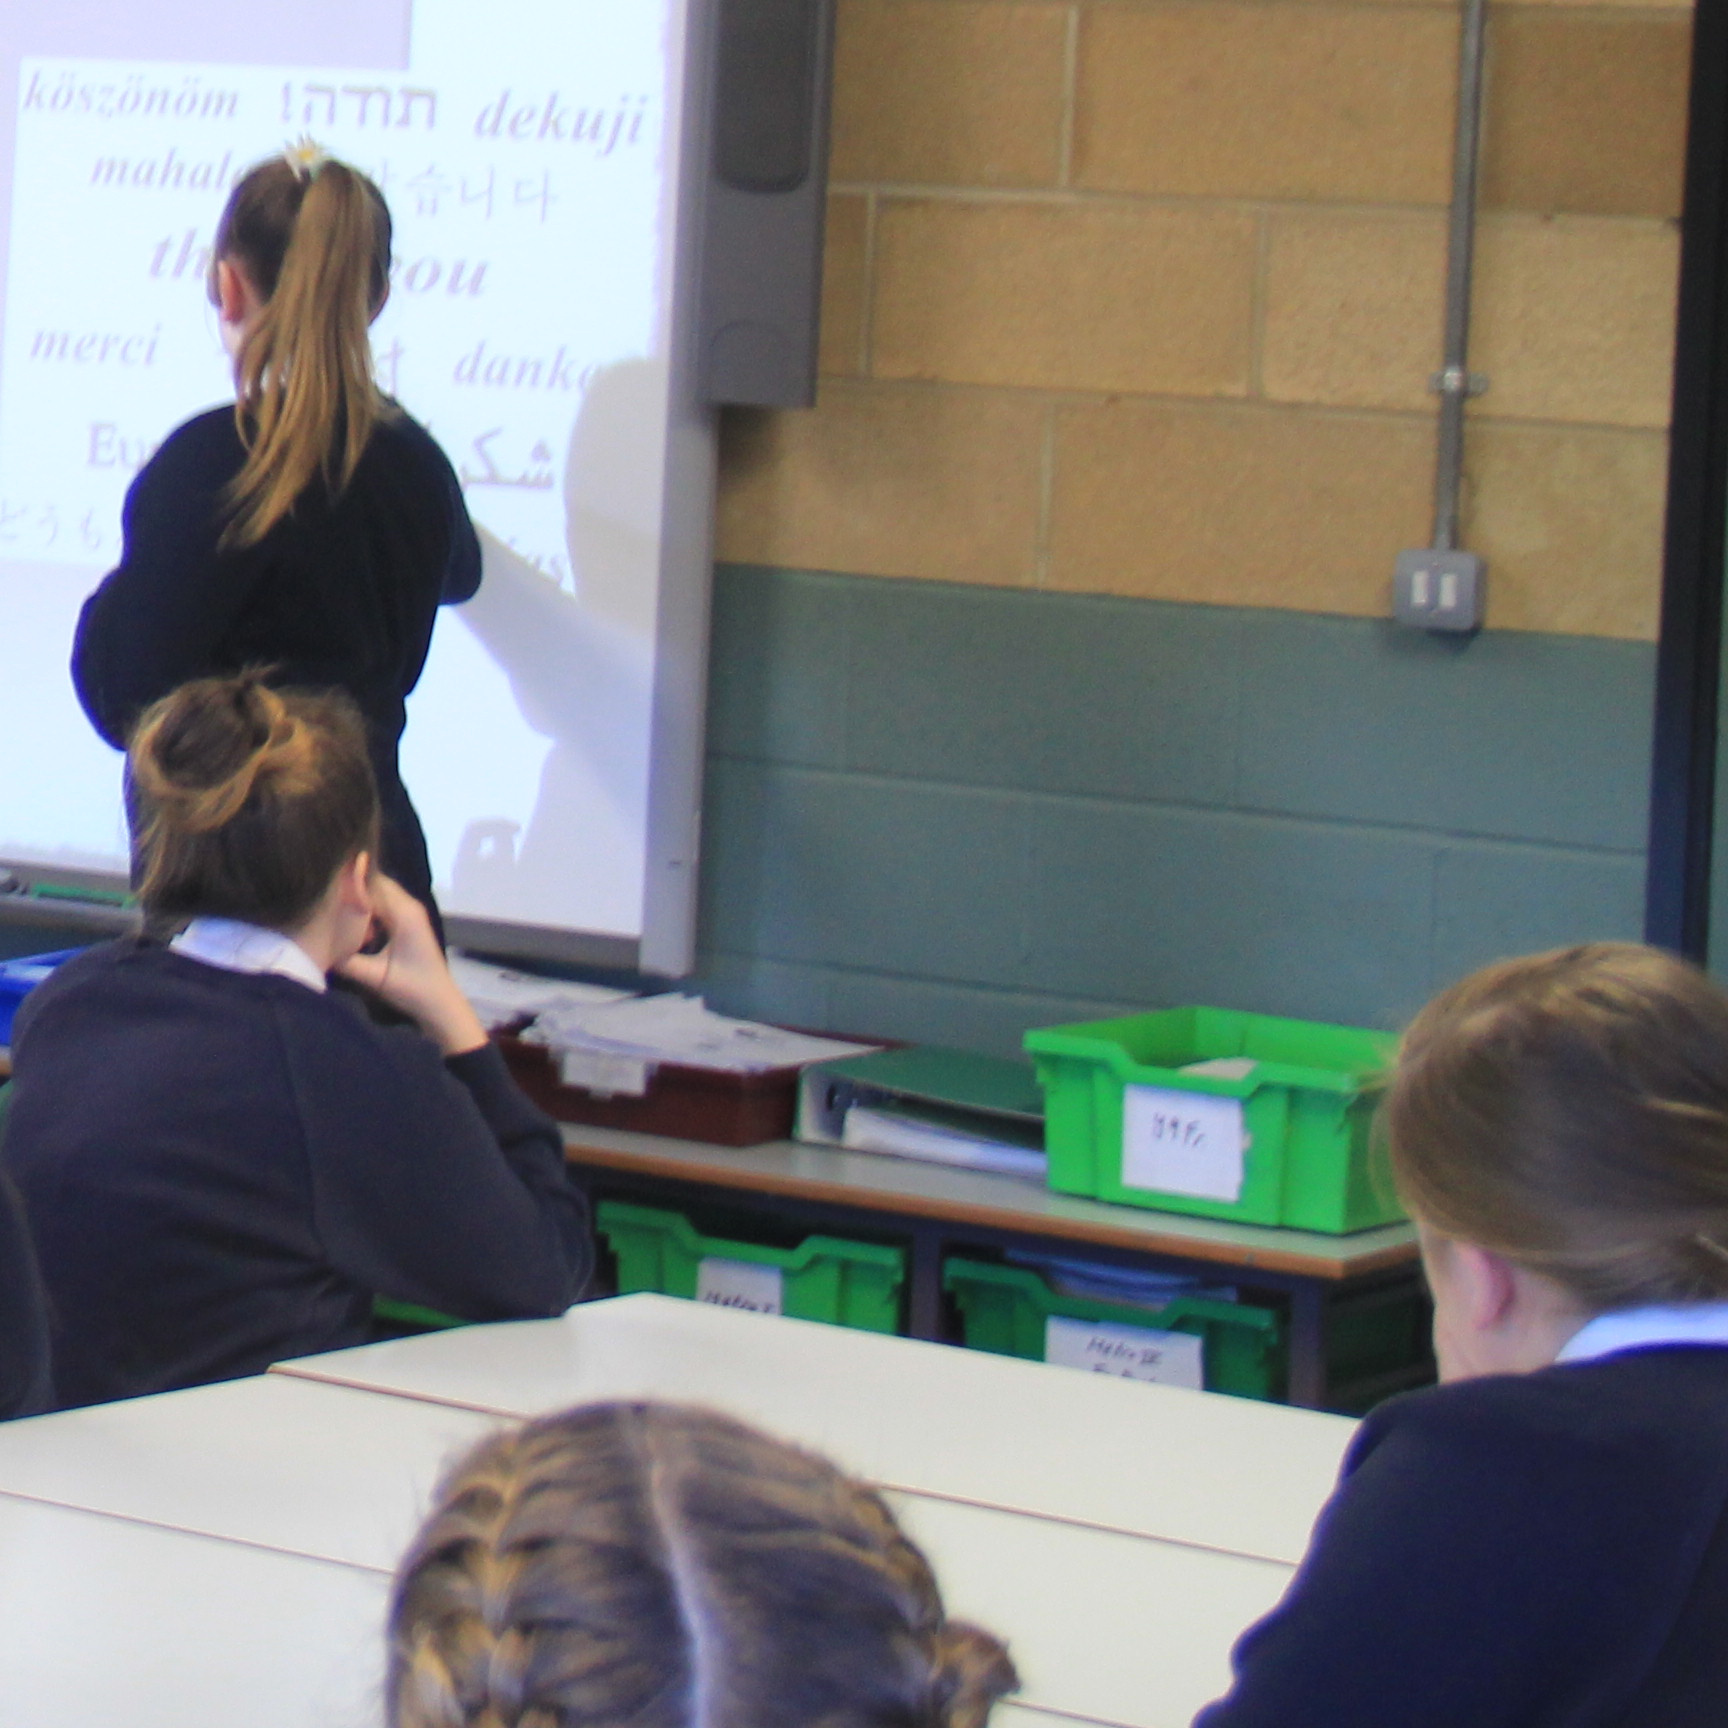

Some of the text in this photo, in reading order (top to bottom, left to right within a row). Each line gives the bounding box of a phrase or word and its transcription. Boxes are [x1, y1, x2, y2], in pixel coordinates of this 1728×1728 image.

[23, 69, 240, 122] köszönöm
[280, 80, 440, 132] תודה!
[472, 85, 652, 160] dekuji
[90, 145, 244, 193] mahal
[389, 252, 493, 300] ou
[29, 319, 164, 369] merci
